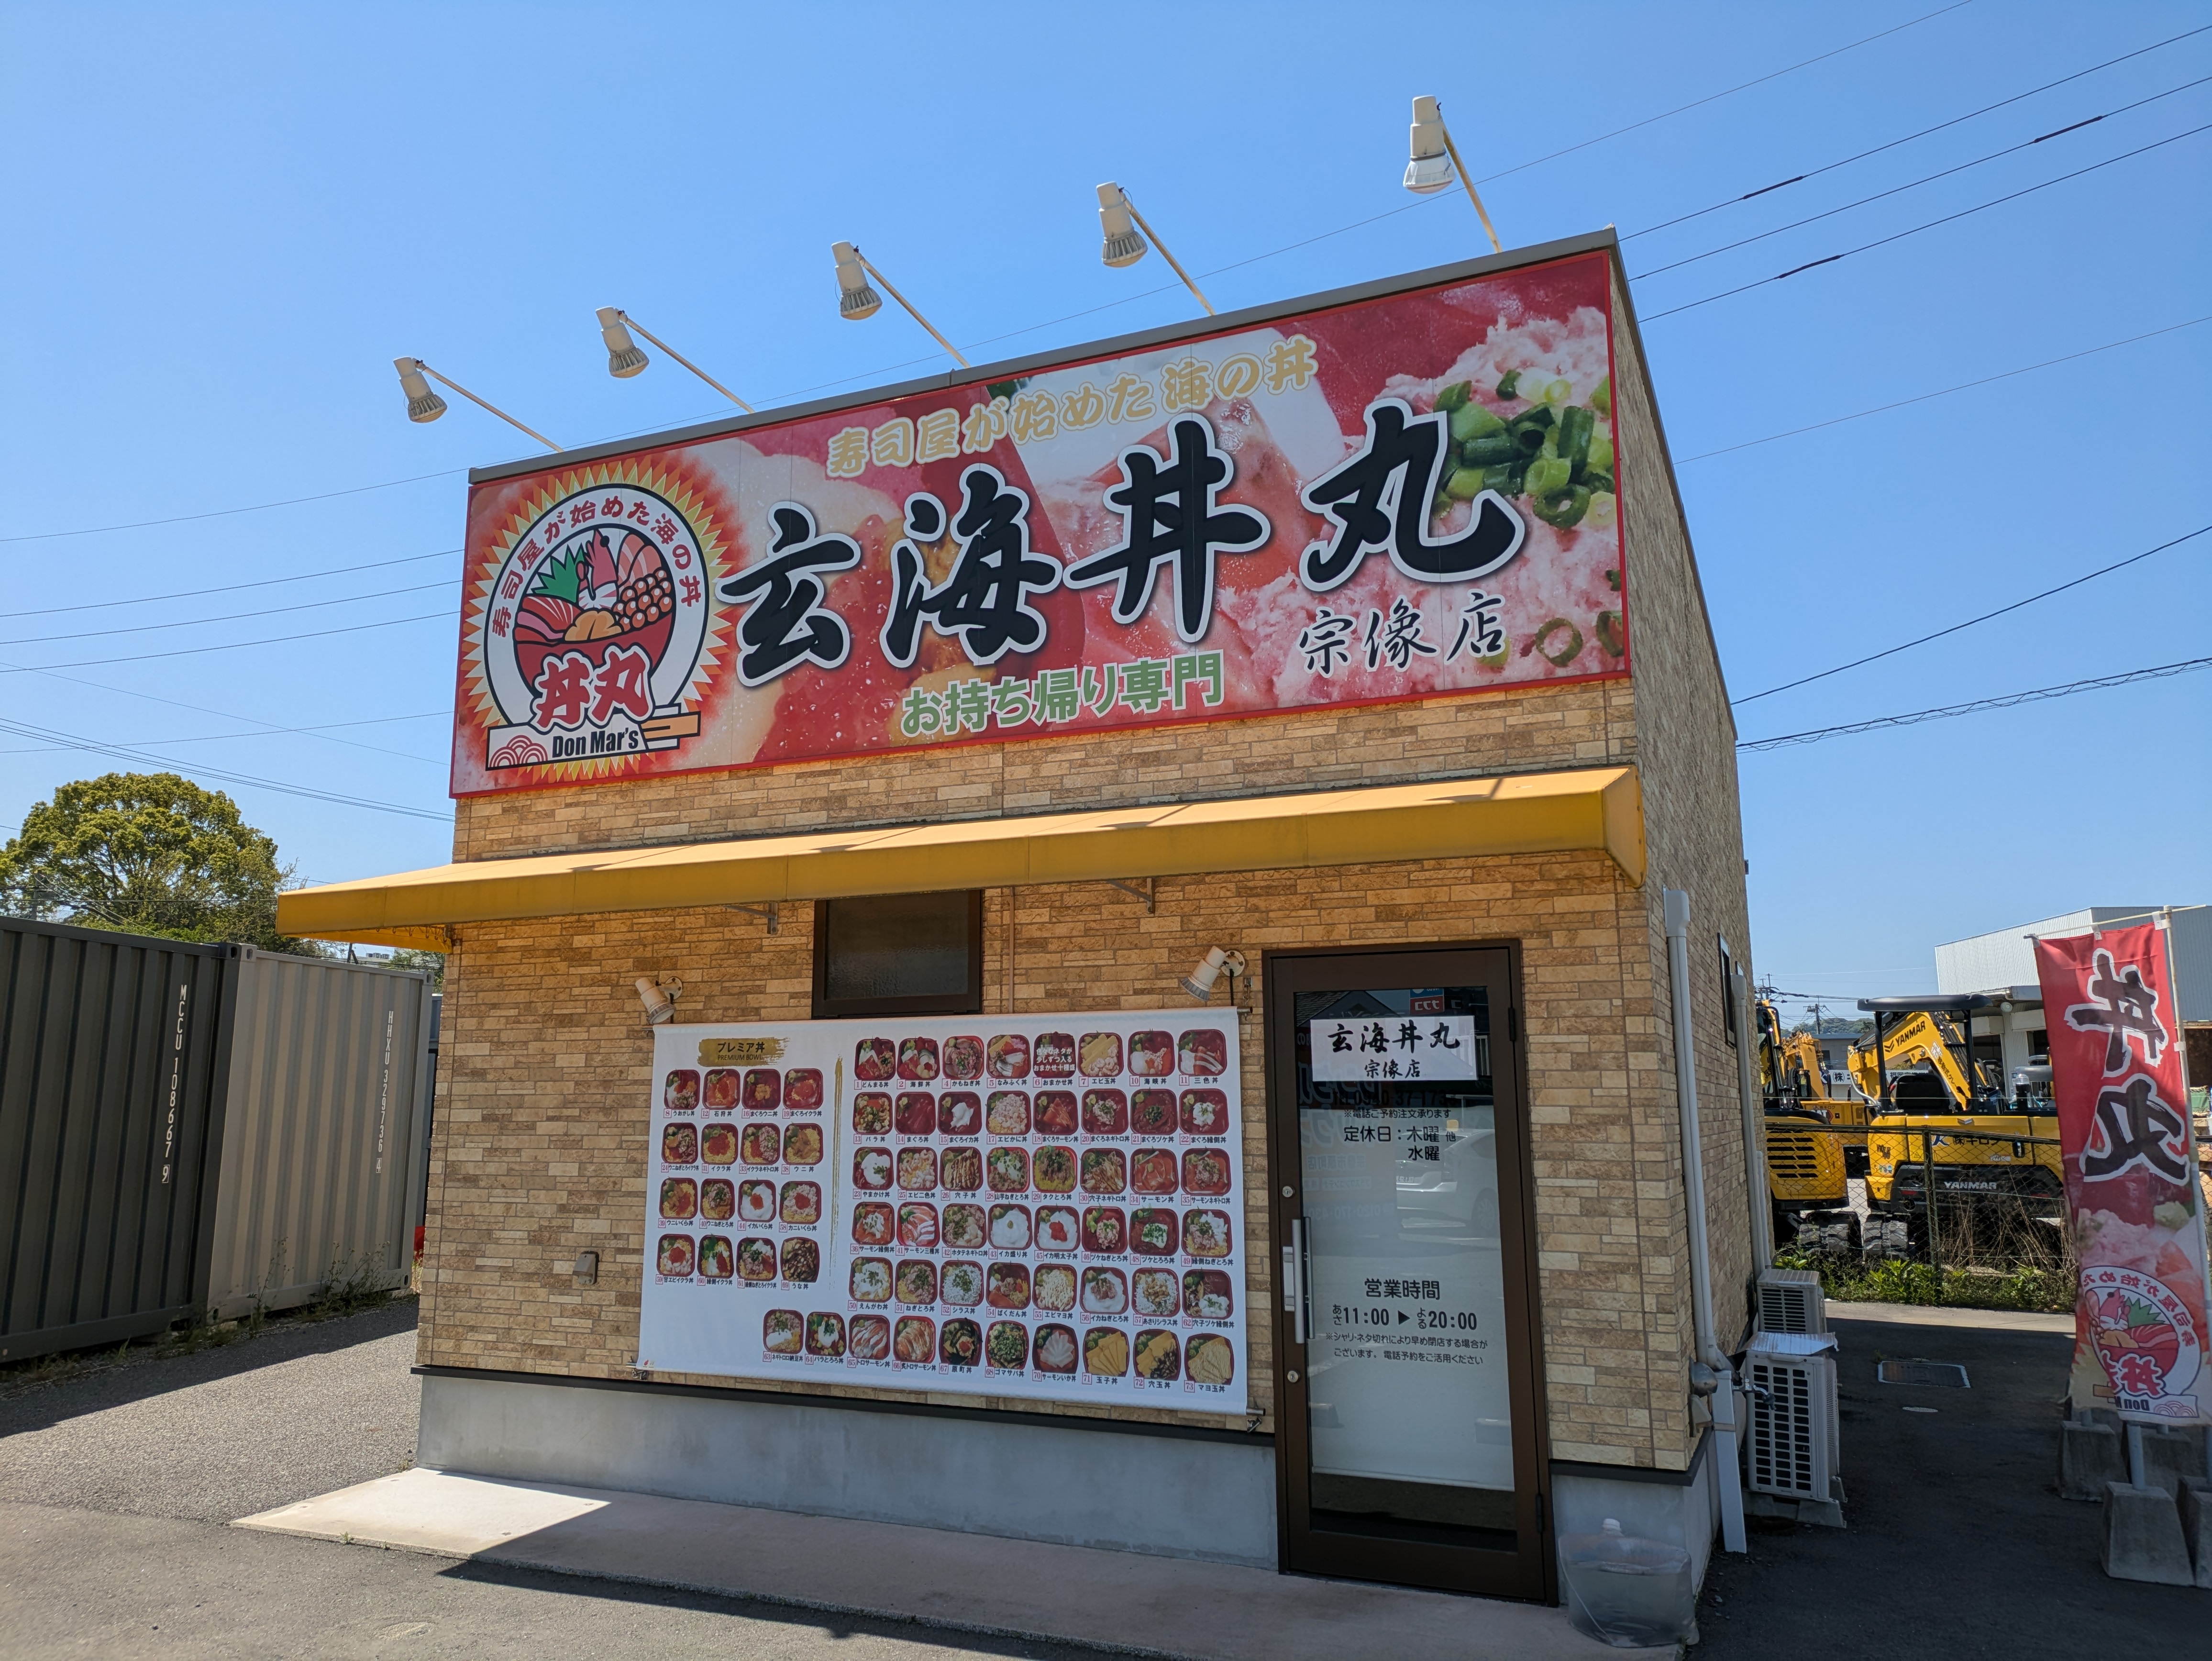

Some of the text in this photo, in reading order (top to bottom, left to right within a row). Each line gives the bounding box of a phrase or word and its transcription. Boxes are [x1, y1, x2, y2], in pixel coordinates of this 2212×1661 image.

[826, 334, 1319, 477] 寿司屋が始めた海の丼
[719, 400, 1524, 684] 玄海丼丸
[491, 495, 701, 638] 寿司屋が始めた海の丼
[1296, 593, 1510, 675] 宗像店
[535, 650, 650, 728] 丼丸
[900, 652, 1224, 739] お持ち帰り専門
[552, 728, 639, 758] Don Mar's
[384, 1010, 393, 1065] HHXU
[1327, 1019, 1460, 1054] 玄海丼丸
[1895, 1020, 1925, 1047] YANMAR
[717, 1041, 765, 1053] プレミア丼
[1364, 1059, 1420, 1079] 宗像店
[163, 984, 187, 1182] MCCU 108667 9
[378, 1070, 388, 1152] 329736
[1445, 1131, 1457, 1142] 他
[1408, 1145, 1440, 1162] 水曜
[1944, 1182, 1997, 1190] YANMAR
[1364, 1278, 1441, 1301] 営業時間
[1045, 1311, 1073, 1319] エビマヨ丼
[1332, 1304, 1478, 1330] あさ 11:00 よる 20:00
[857, 1359, 890, 1368] トロサーモン丼
[1042, 1373, 1076, 1382] サーモンいか丼
[1096, 1376, 1118, 1384] 玉子丼
[1149, 1381, 1170, 1389] 穴玉丼
[1198, 1384, 1226, 1393] マヨ玉丼
